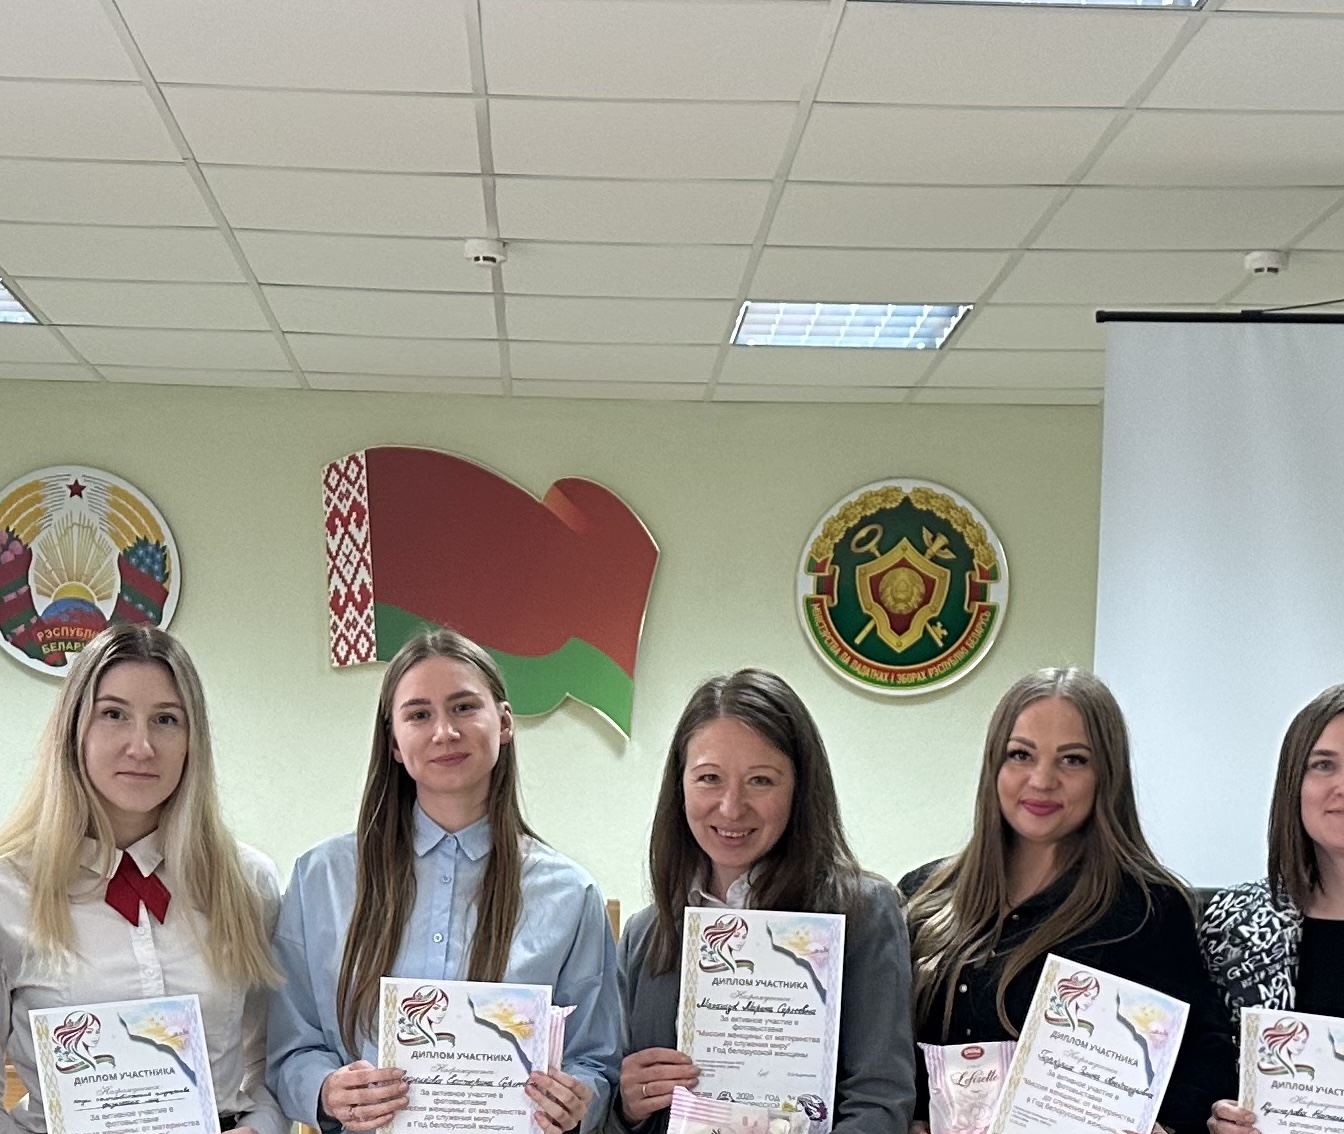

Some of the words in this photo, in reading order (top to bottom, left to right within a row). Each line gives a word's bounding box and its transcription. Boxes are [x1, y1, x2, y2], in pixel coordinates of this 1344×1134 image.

[896, 672, 927, 684] ЗБОРАХ
[712, 976, 752, 987] ДИПЛОМ
[411, 1050, 454, 1060] ДИПЛОМ
[456, 1052, 512, 1062] УЧАСТНИКА
[73, 1072, 117, 1086] ДИПЛОМ
[118, 1066, 175, 1080] УЧАСТНИКА
[1270, 1079, 1313, 1093] ДИПЛОМ
